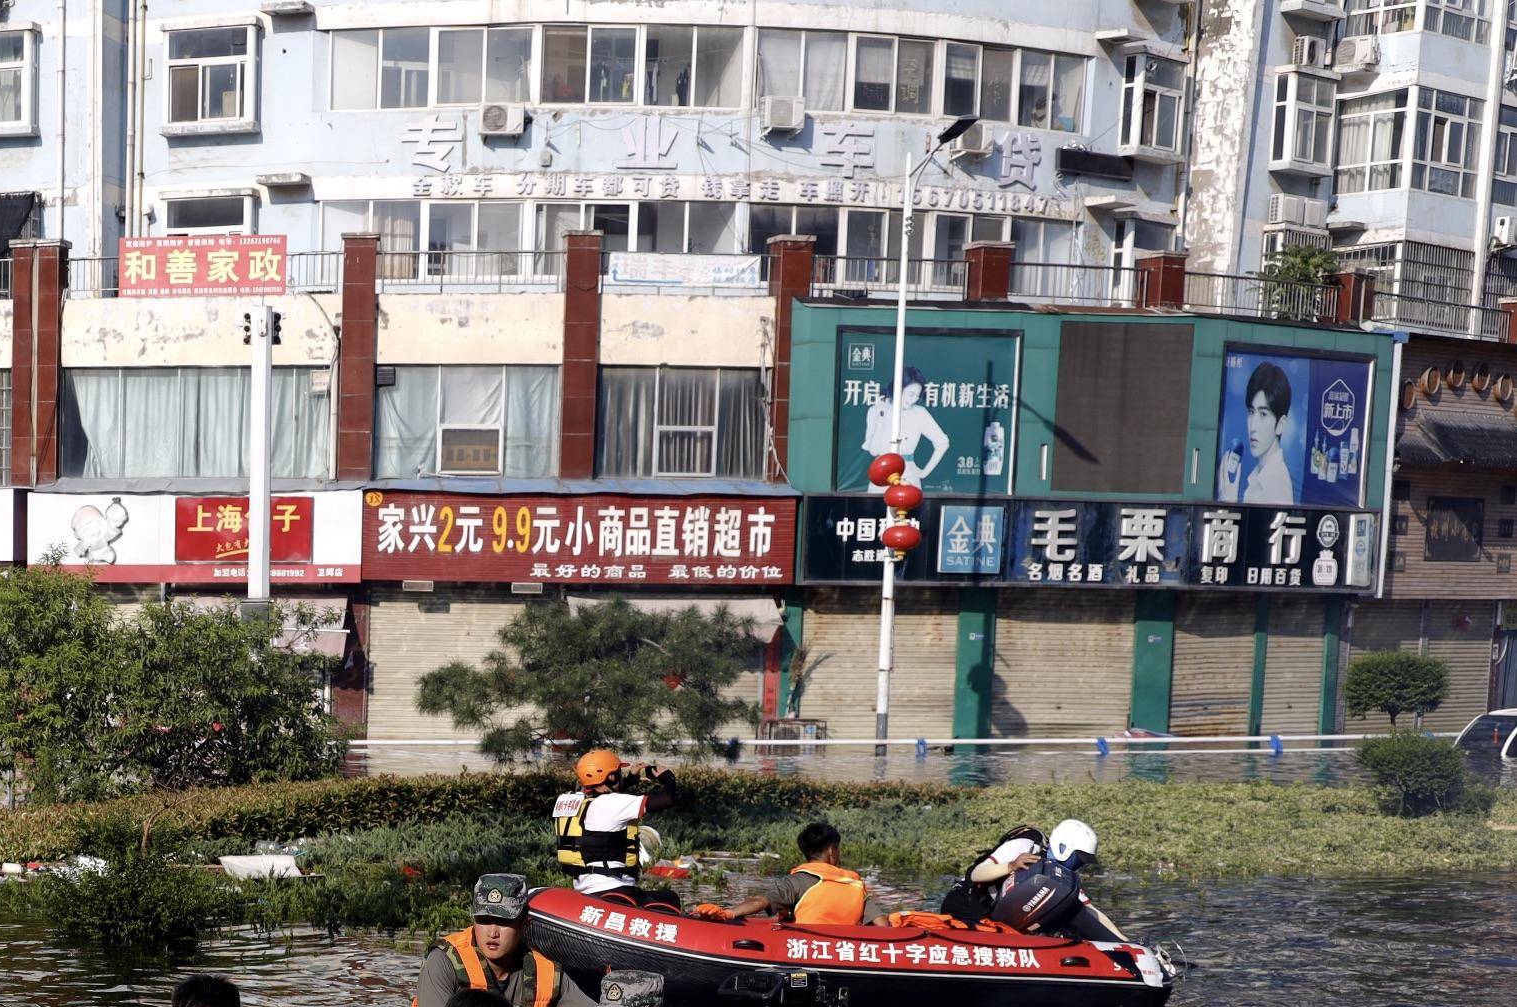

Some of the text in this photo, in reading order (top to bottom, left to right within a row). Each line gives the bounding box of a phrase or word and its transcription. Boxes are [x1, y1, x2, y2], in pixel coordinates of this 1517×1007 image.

[124, 248, 282, 285] 和善家政
[923, 382, 1010, 410] 有机新生活
[1322, 401, 1354, 422] 新上市
[187, 504, 301, 533] 上海子
[376, 503, 484, 555] 家兴2元
[946, 514, 998, 555] 金典
[1030, 507, 1307, 565] 毛栗商行
[529, 562, 784, 580] 最好的商品 最低的价位
[946, 555, 996, 568] SATINE
[1026, 563, 1104, 582] 名烟名酒
[1124, 565, 1161, 584] 礼品
[1200, 566, 1229, 585] 复印
[1246, 567, 1302, 586] 日用百货
[1027, 886, 1051, 910] YAMAHA
[579, 904, 679, 944] 新昌救援
[786, 938, 1041, 969] 浙江省红十字应急搜救队
